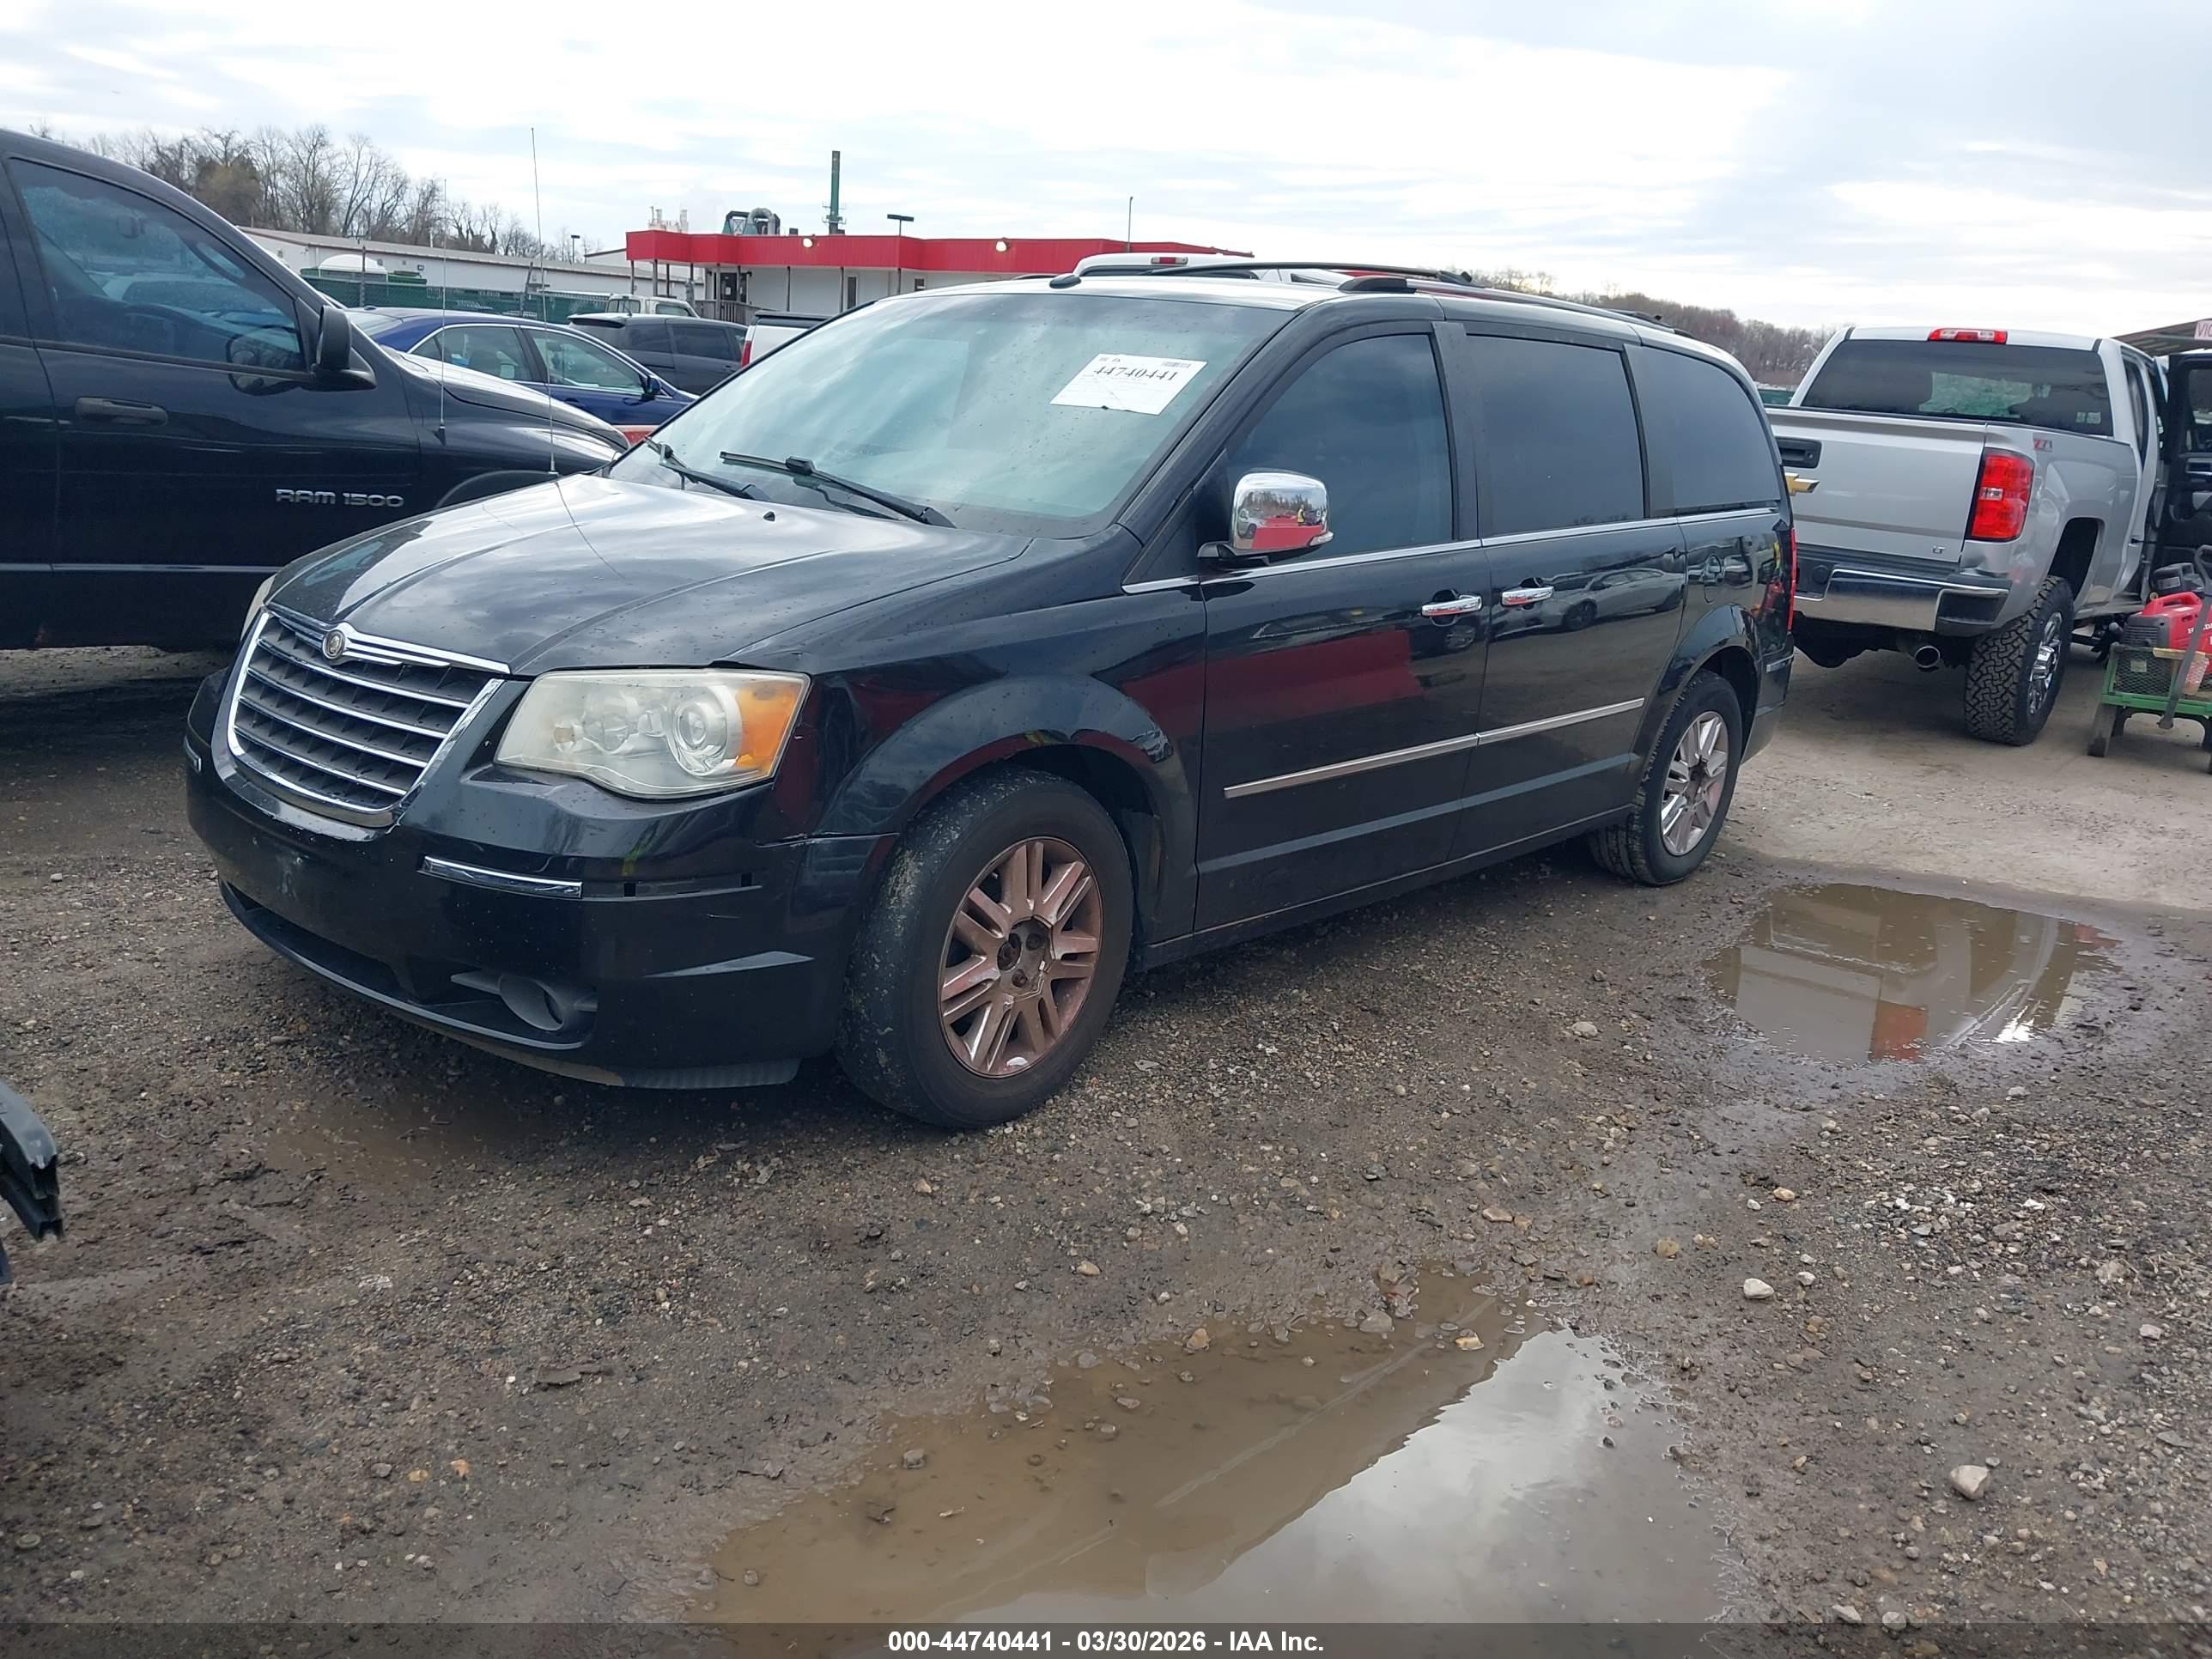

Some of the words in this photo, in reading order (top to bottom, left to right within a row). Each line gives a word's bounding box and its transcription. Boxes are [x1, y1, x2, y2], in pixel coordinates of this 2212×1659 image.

[1093, 365, 1178, 381] 44740441
[276, 489, 336, 505] RAM
[343, 492, 404, 507] 1500
